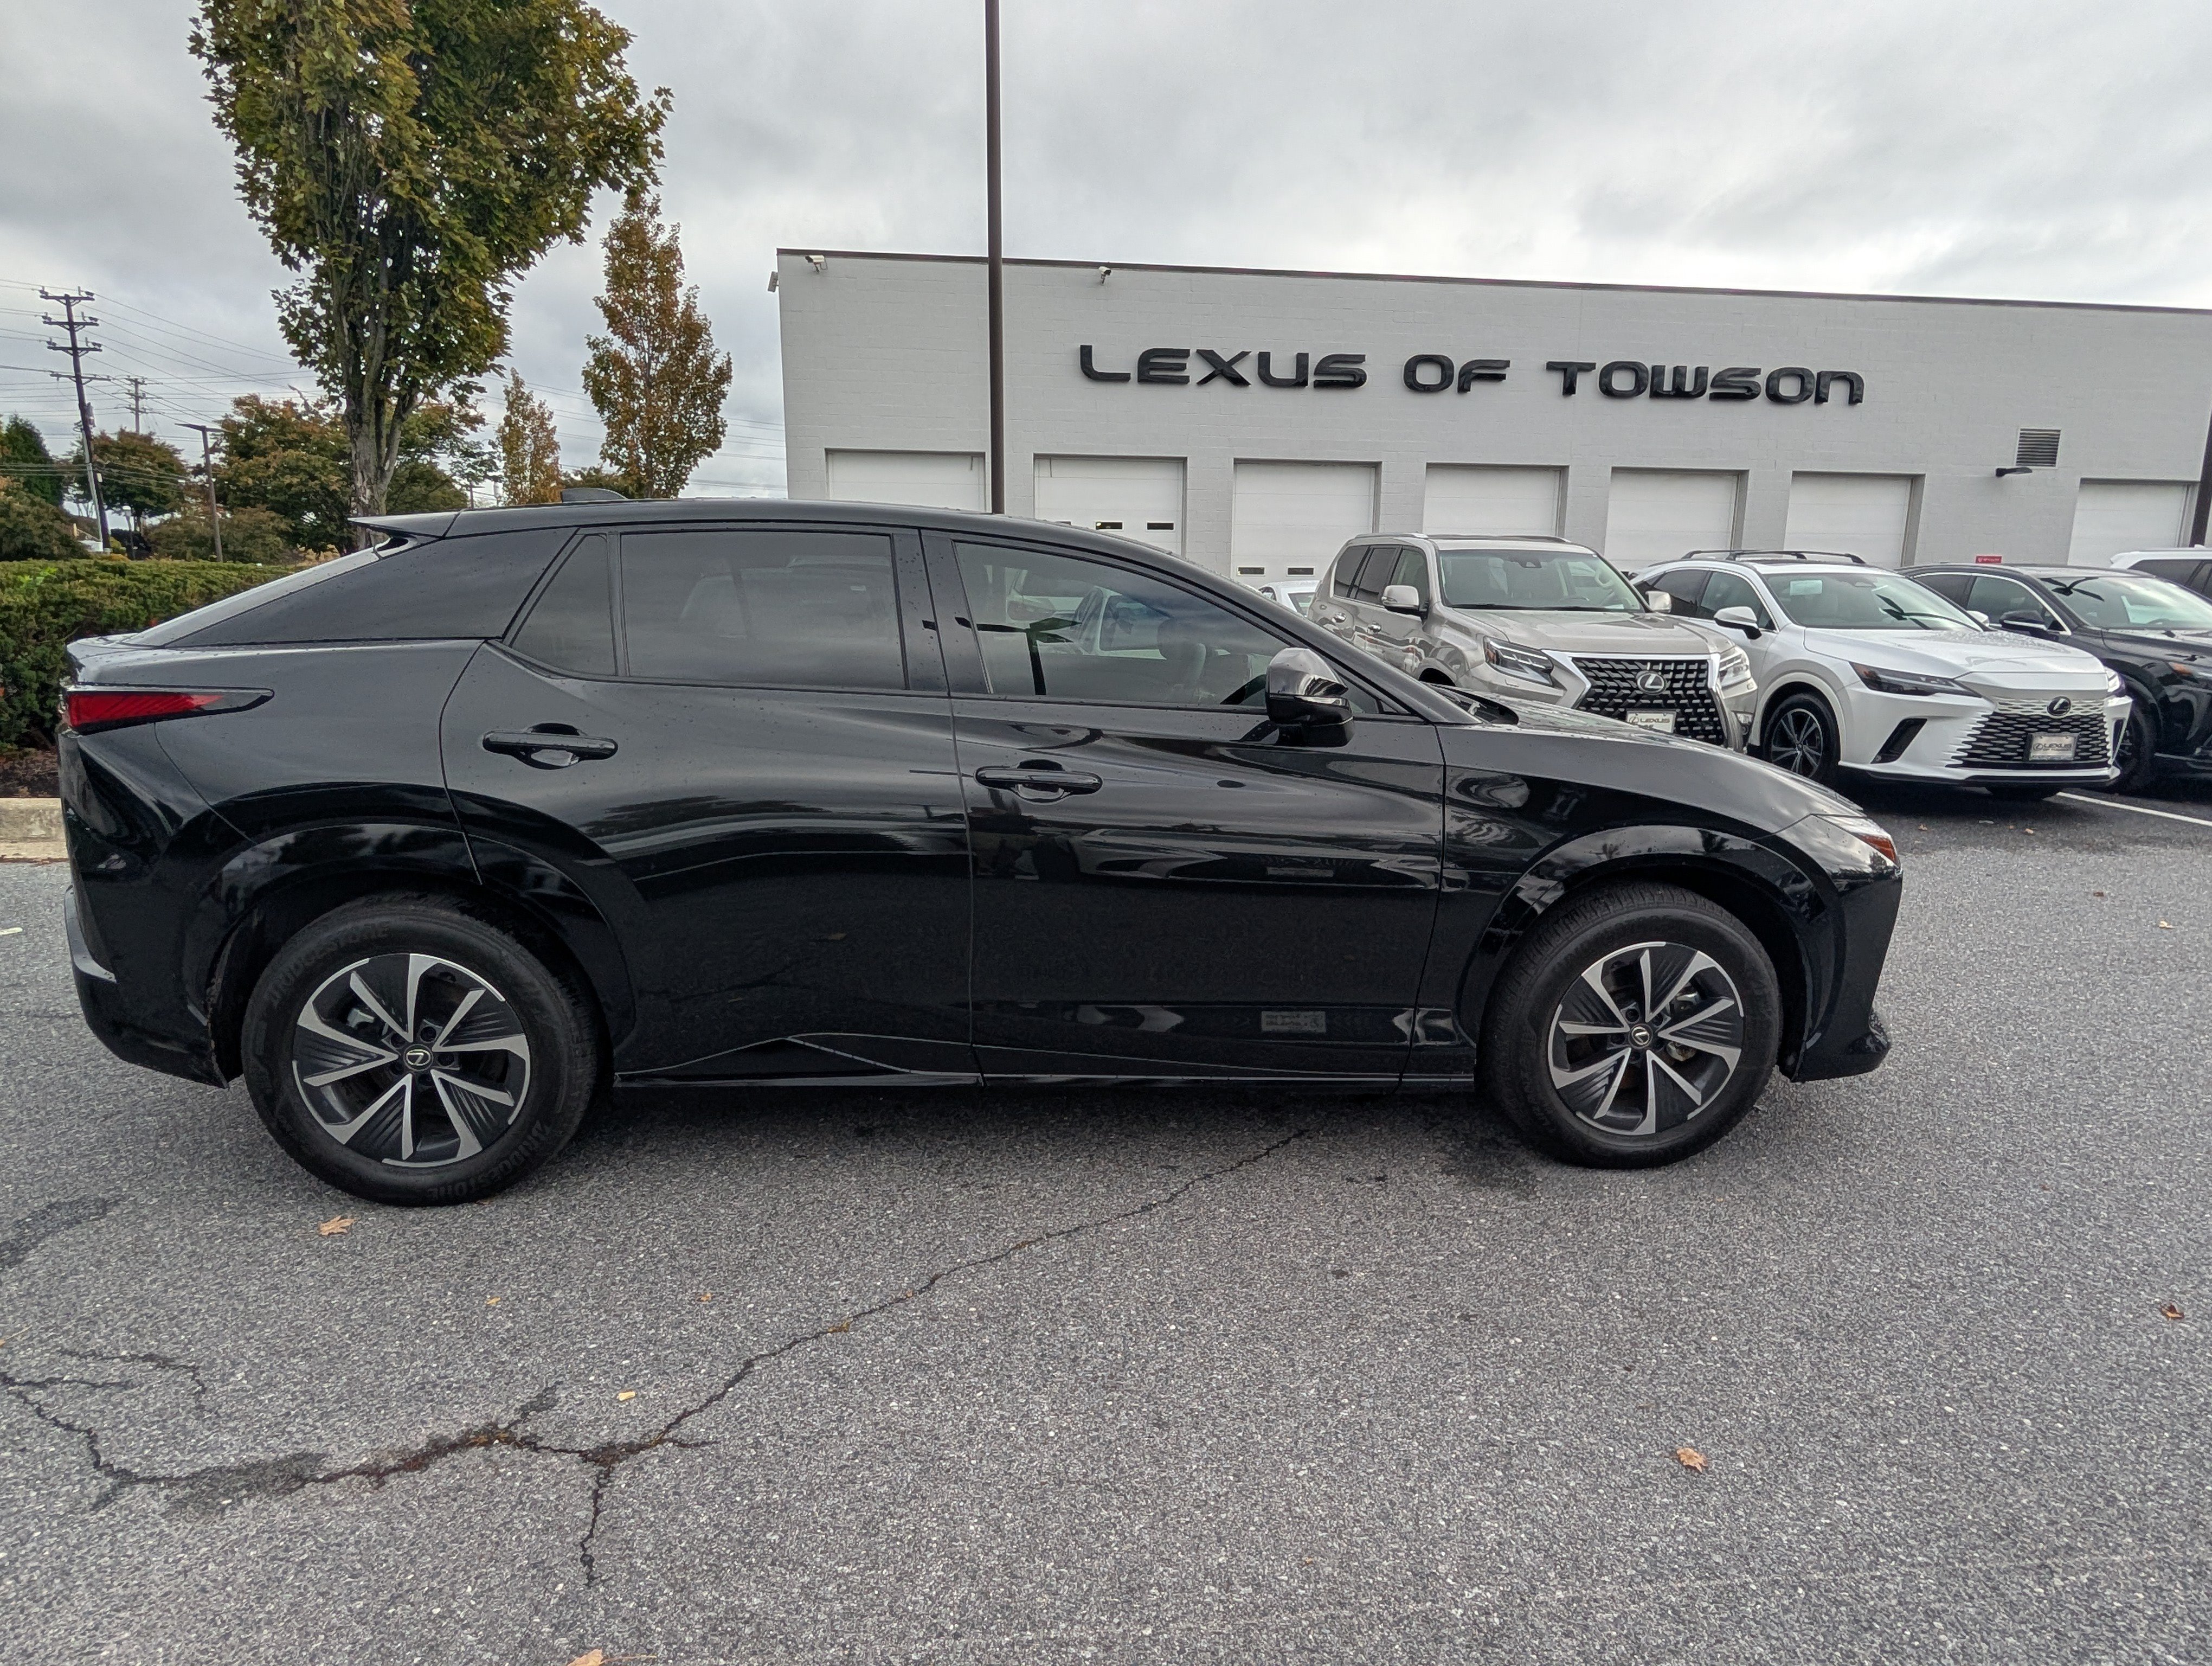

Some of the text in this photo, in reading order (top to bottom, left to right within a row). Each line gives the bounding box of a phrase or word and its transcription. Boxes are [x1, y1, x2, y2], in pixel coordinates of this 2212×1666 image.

[1079, 344, 1865, 405] LEXUS OF TOWSON
